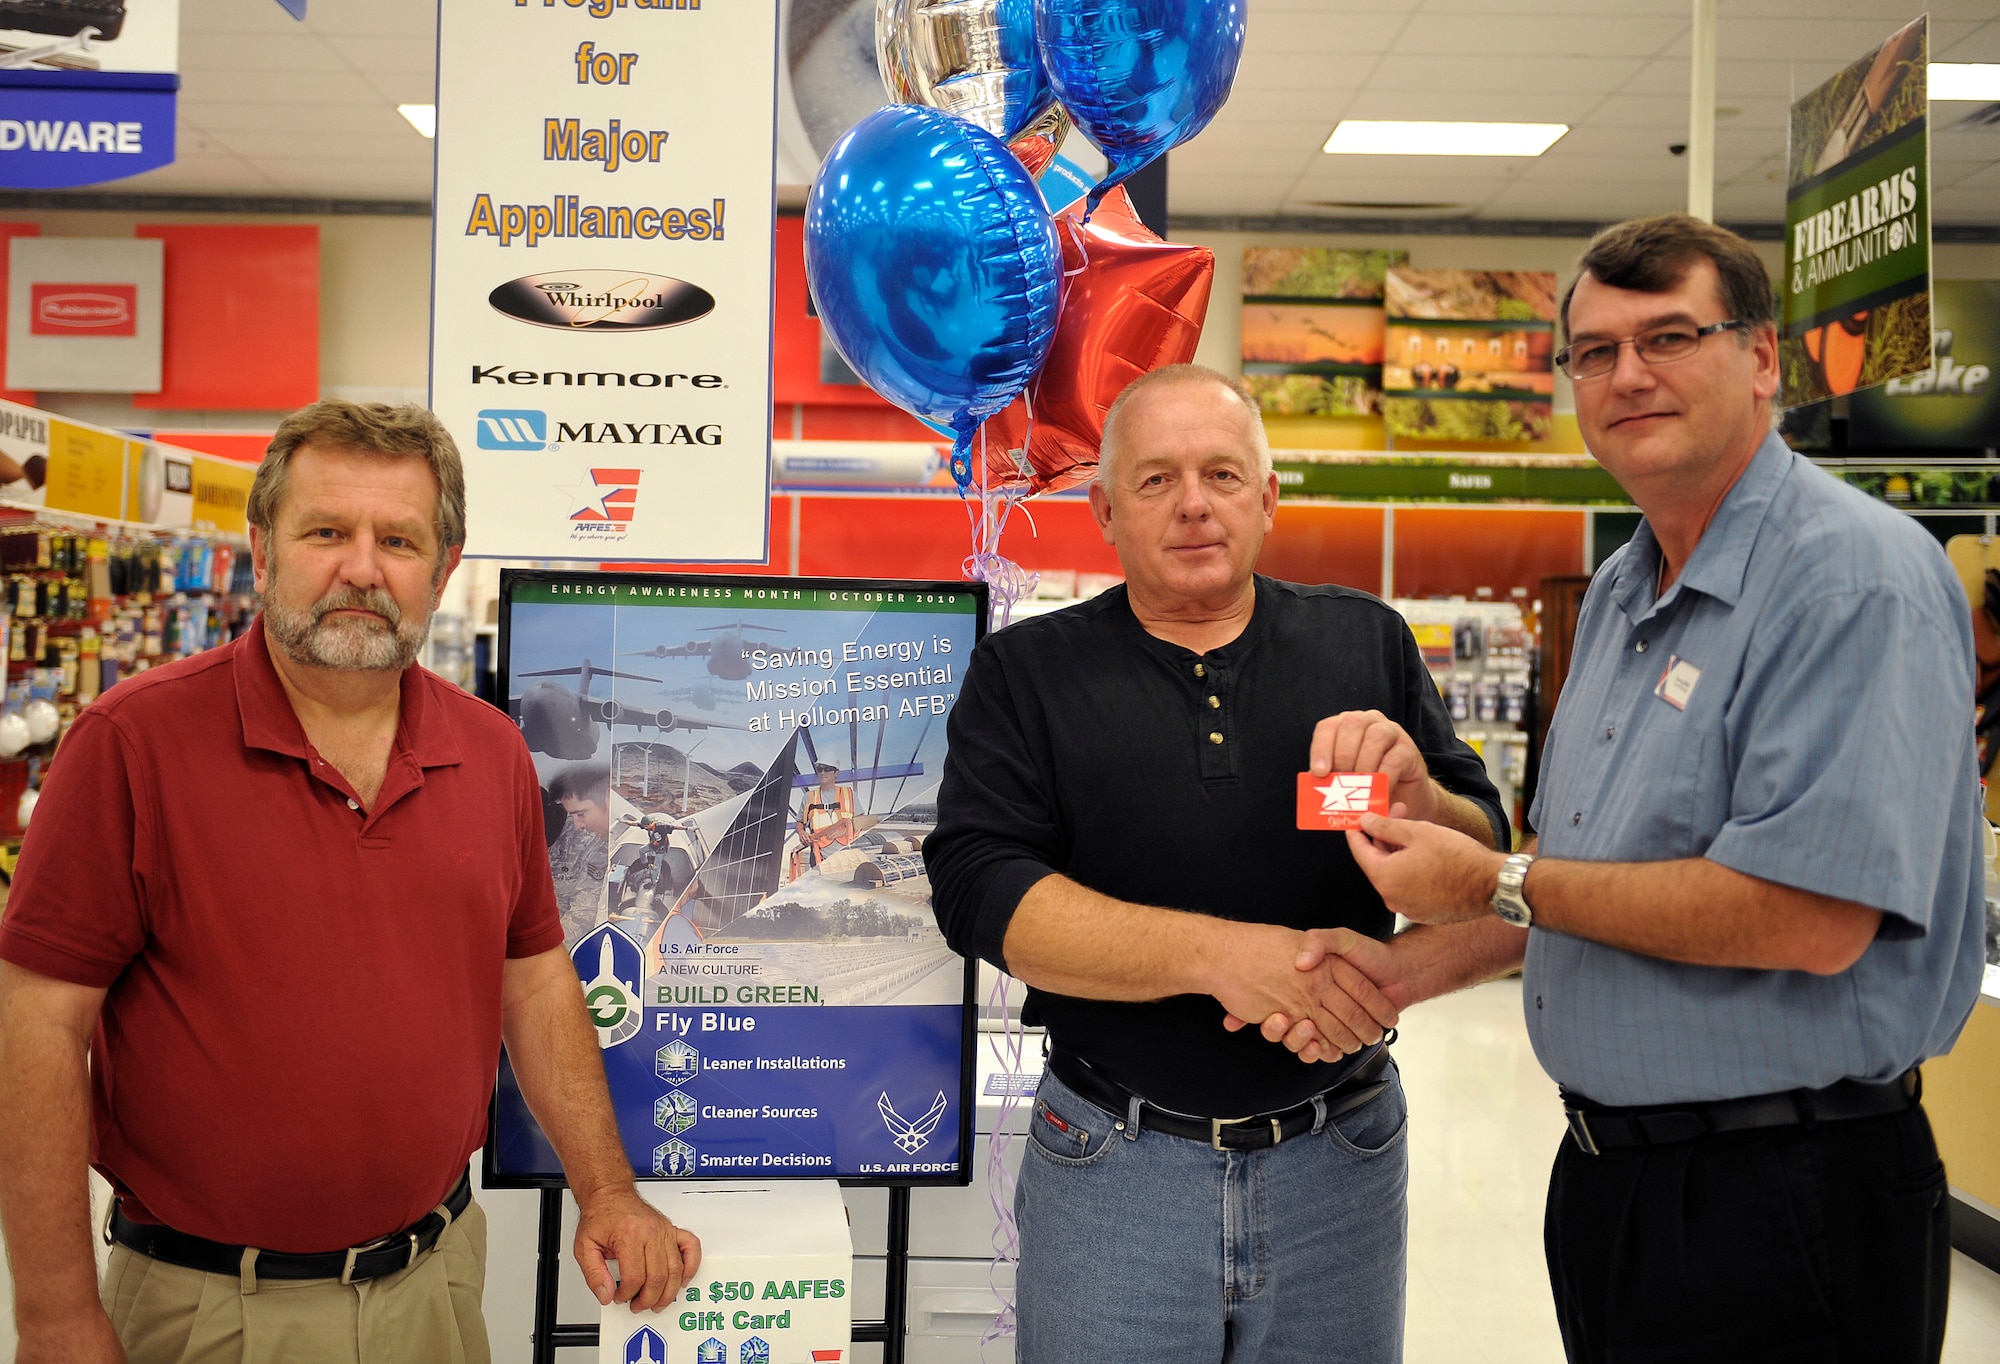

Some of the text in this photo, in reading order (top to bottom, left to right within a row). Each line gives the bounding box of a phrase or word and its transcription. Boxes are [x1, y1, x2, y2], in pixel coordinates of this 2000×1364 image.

[575, 41, 639, 85] for
[543, 118, 669, 173] Major
[465, 193, 726, 248] Appliances!
[1792, 165, 1917, 263] FIREARMS
[1791, 212, 1917, 295] & AMMUNITION
[544, 291, 664, 311] Whirlpool
[471, 365, 723, 389] Kenmore
[555, 421, 723, 446] MAYTAG
[551, 584, 617, 595] ENERGY
[630, 586, 731, 598] AWARENESS
[744, 589, 800, 600] MONTH
[829, 591, 905, 603] OCTOBER
[916, 594, 956, 604] 2010
[842, 640, 925, 662] Energy
[933, 635, 952, 654] is
[746, 664, 953, 701] Mission Essential
[749, 712, 770, 732] at
[779, 704, 889, 730] Holloman
[659, 943, 739, 954] U.S. Air Force
[659, 965, 762, 975] A NEW CULTURE:
[657, 986, 825, 1006] BUILD GREEN,
[656, 1012, 756, 1036] Fly Blue
[703, 1056, 846, 1070] Leaner Installations
[702, 1105, 818, 1119] Cleaner Sources
[700, 1152, 832, 1167] Smarter Decisions
[860, 1162, 959, 1172] U.S. AIR FORCE
[686, 1287, 701, 1302] a
[708, 1281, 754, 1303] $50
[761, 1279, 846, 1301] AAFES
[679, 1309, 791, 1332] Gift Card
